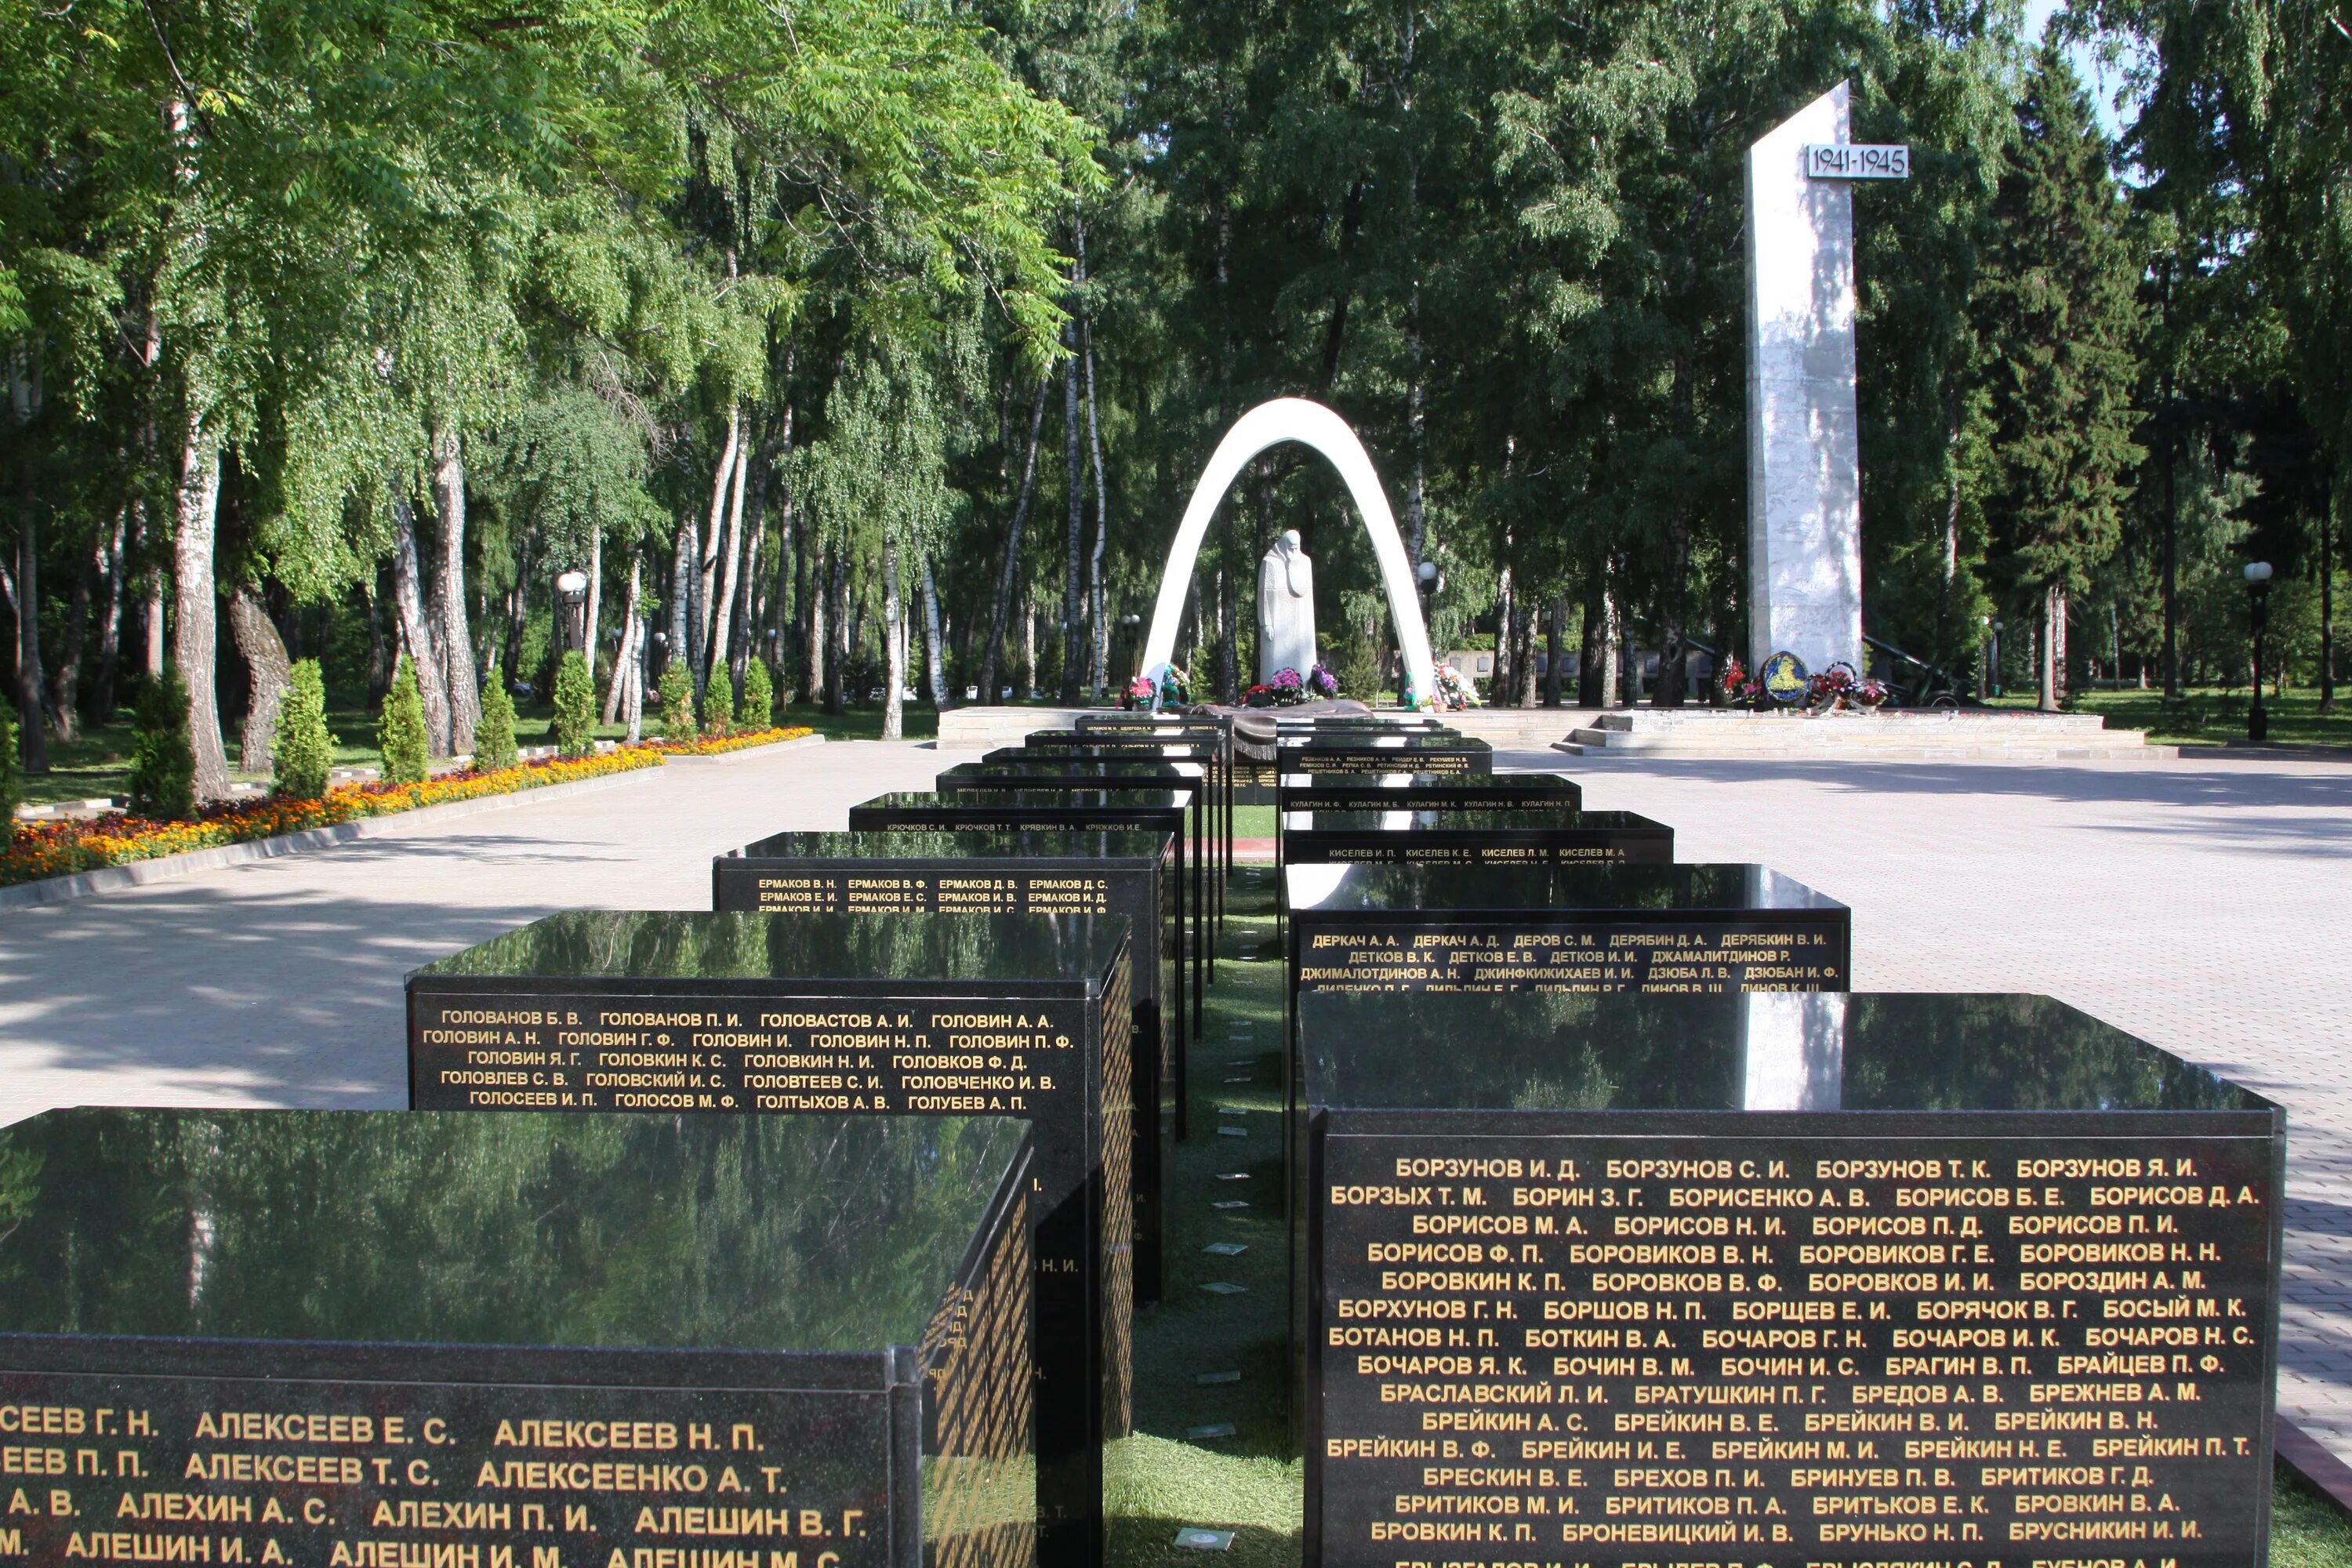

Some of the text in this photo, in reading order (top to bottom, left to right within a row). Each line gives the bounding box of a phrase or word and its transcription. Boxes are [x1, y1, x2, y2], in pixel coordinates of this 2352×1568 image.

[1813, 148, 1905, 174] 1941-1945
[1329, 848, 1374, 858] КИСЕЛЕВ
[1375, 848, 1385, 858] И.
[1387, 848, 1396, 858] П.
[1406, 848, 1450, 858] КИСЕЛЕВ
[1452, 848, 1461, 858] К.
[1463, 848, 1472, 858] Е.
[1481, 848, 1526, 858] КИСЕЛЕВ
[1527, 848, 1537, 858] Л.
[1539, 848, 1549, 858] М.
[1559, 848, 1603, 858] КИСЕЛЕВ
[1605, 848, 1616, 858] М.
[759, 879, 1108, 891] ЕРМАКОВ В. Н. ЕРМАКОВ В. Ф. ЕРМАКОВ Д. В. ЕРМАКОВ Д. С.
[1312, 934, 1826, 949] ДЕРКАЧ А. А. ДЕРКАЧ А. Д. ДЕРОВ С. М. ДЕРЯБИН Д. А. ДЕРЯБКИН В. И.
[1300, 967, 1428, 982] ДЖИМАЛОТДИНОВ
[1430, 968, 1443, 979] А.
[1447, 967, 1461, 979] Н.
[1604, 967, 1617, 979] И.
[1621, 967, 1634, 979] И.
[1648, 967, 1698, 981] ДЗЮБА
[1700, 967, 1714, 978] Л.
[1718, 967, 1731, 978] В.
[1744, 967, 1804, 980] ДЗЮБАН
[1807, 967, 1820, 978] И.
[1824, 967, 1838, 978] Ф.
[441, 1010, 1054, 1029] ГОЛОВАНОВ Б. В. ГОЛОВАНОВ П. И. ГОЛОВАСТОВ А. И. ГОЛОВИН А. А.
[1396, 1158, 2198, 1181] БОРЗУНОВ И. Д. БОРЗУНОВ С. И. БОРЗУНОВ Т. К. БОРЗУНОВ Я. И.
[1338, 1296, 2247, 1323] БОРХУНОВ Г. Н. БОРШОВ Н. П. БОРЩЕВ Е. И. БОРЯЧОК В. Г. БОСЫЙ М. К.
[96, 1409, 118, 1435] Г.
[128, 1410, 158, 1436] Н.
[195, 1412, 373, 1443] АЛЕКСЕЕВ
[384, 1417, 413, 1444] Е.
[423, 1418, 456, 1445] С.
[494, 1420, 677, 1450] АЛЕКСЕЕВ
[689, 1423, 720, 1450] Н.
[732, 1425, 764, 1451] П.
[8, 1488, 866, 1537] А. В. АЛЕХИН А. С. АЛЕХИН П. И. АЛЕШИН В. Г.
